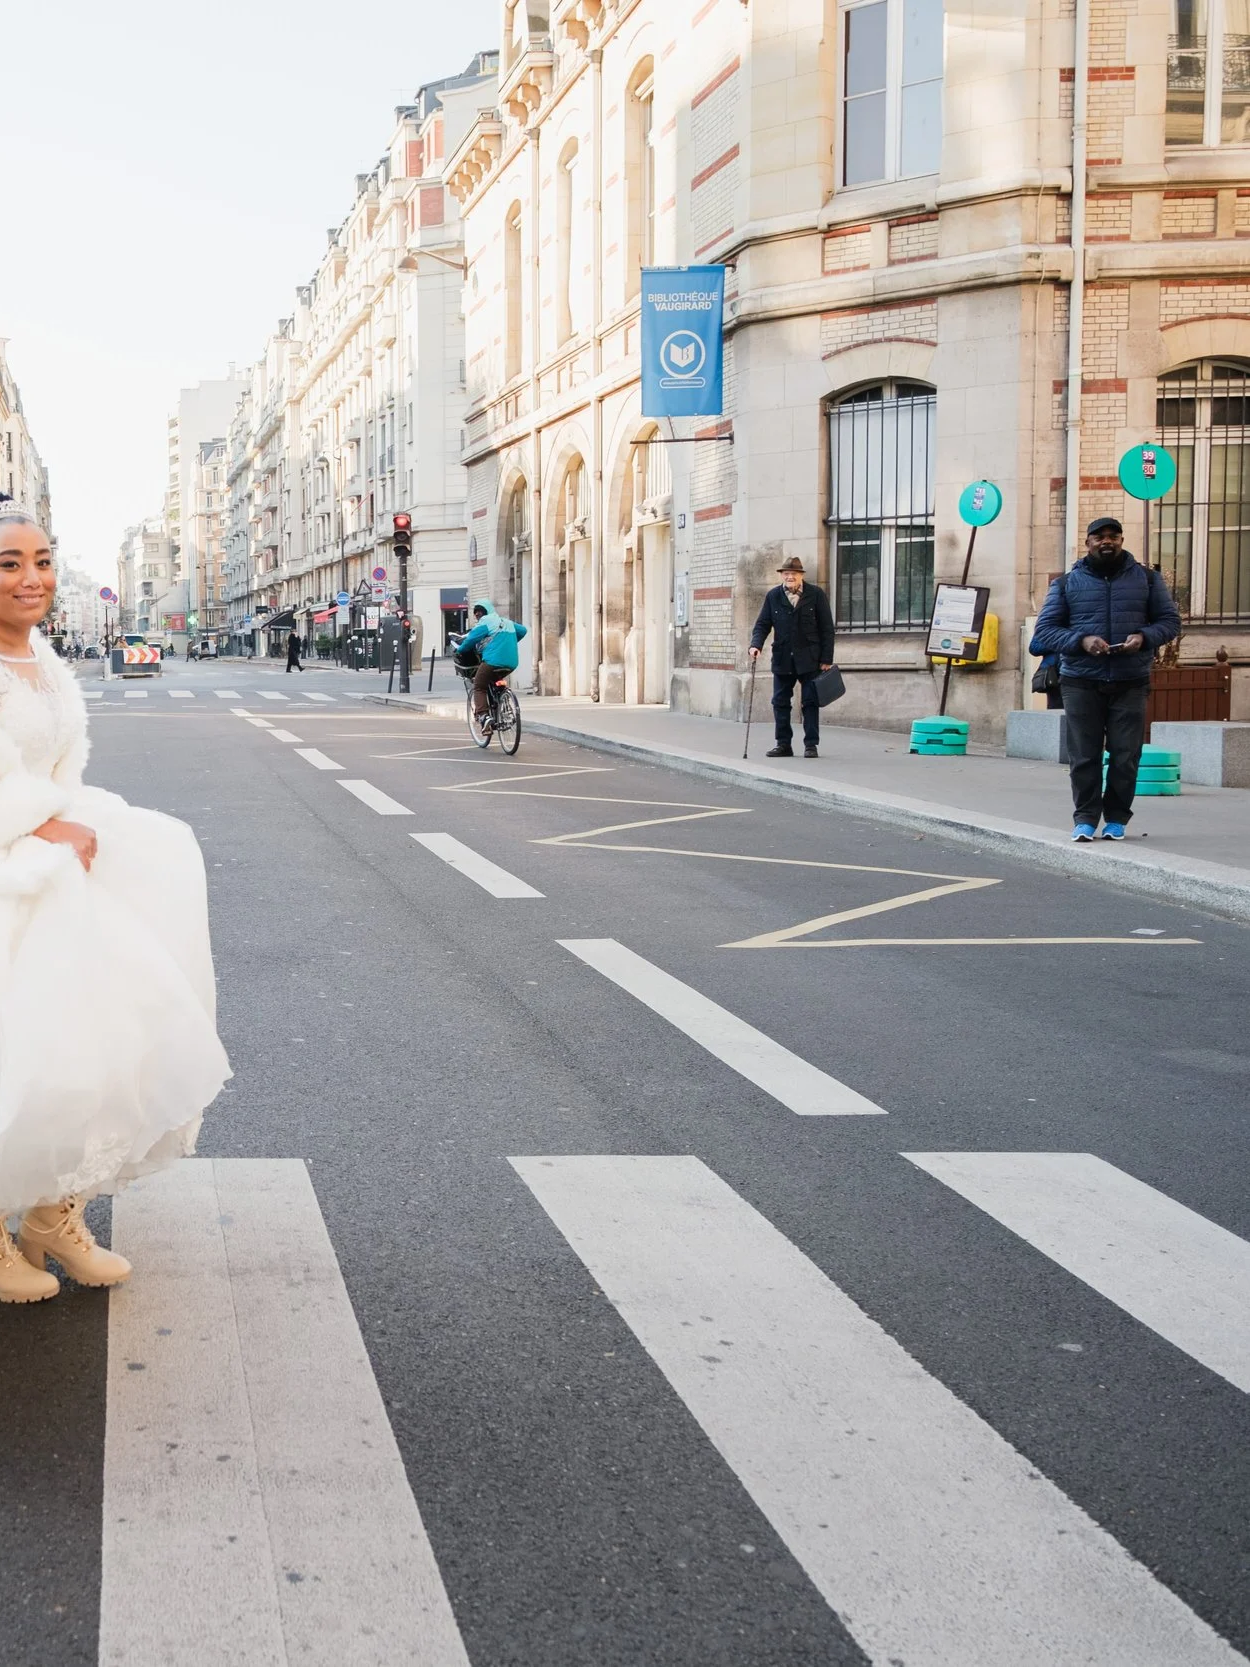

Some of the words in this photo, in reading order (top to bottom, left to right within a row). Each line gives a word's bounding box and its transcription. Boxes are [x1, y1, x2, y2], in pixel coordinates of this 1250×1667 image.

[654, 301, 712, 312] VAUGIRARD
[1142, 451, 1154, 460] 39
[1143, 465, 1154, 474] 80
